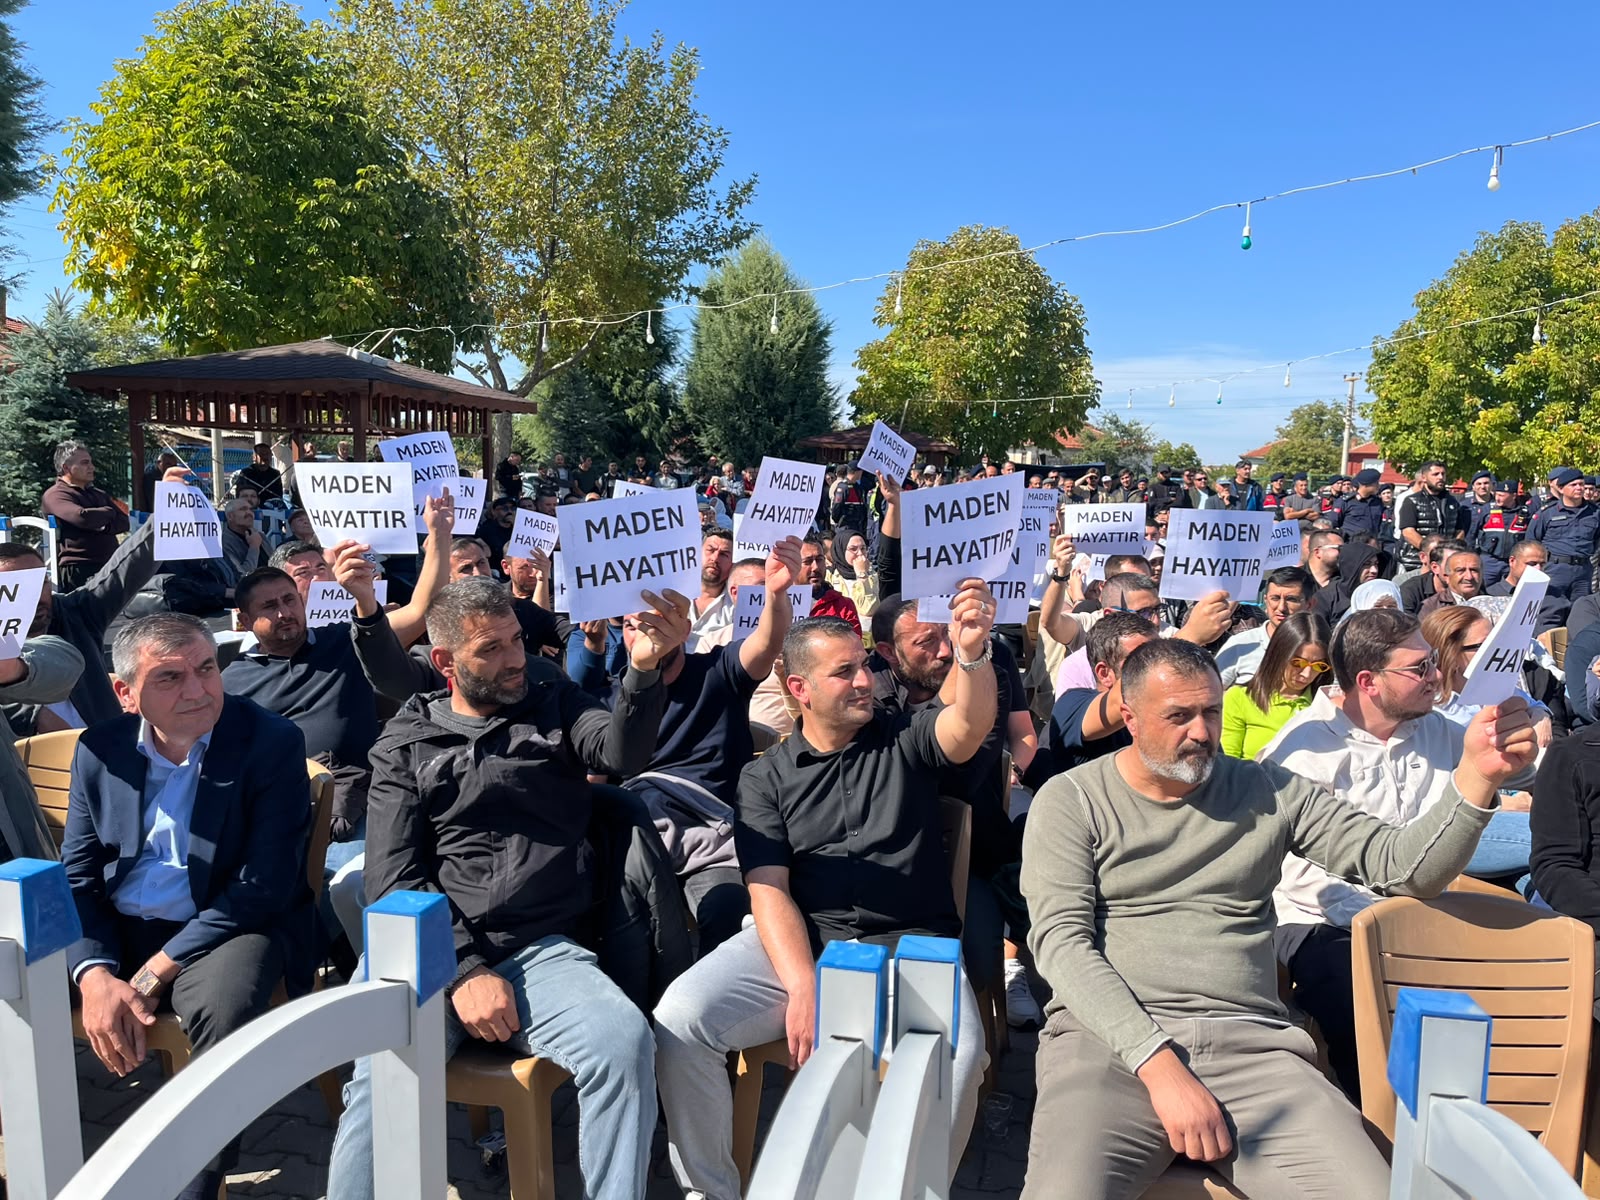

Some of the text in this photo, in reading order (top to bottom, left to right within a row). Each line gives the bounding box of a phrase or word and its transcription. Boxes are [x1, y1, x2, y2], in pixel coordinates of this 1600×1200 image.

[396, 440, 447, 460] MADEN
[879, 431, 908, 459] MADEN
[868, 446, 905, 479] HAYATTIR
[414, 464, 457, 484] AYATTIR
[770, 471, 815, 493] MADEN
[311, 475, 392, 494] MADEN
[1028, 492, 1053, 501] MADEN
[751, 502, 814, 524] HAYATTIR
[924, 489, 1010, 526] MADEN
[1078, 511, 1133, 523] MADEN
[309, 508, 407, 529] HAYATTIR
[524, 516, 557, 534] MADEN
[585, 505, 684, 543] MADEN
[160, 521, 218, 538] HAYATTIR
[1071, 532, 1139, 544] HAYATTIR
[1188, 522, 1260, 542] MADEN
[1270, 526, 1294, 540] ADEN
[514, 533, 554, 552] HAYATTIR
[737, 541, 771, 553] HAYA
[912, 529, 1014, 570] HAYATTIR
[1267, 543, 1299, 559] AYATTIR
[575, 546, 697, 590] HAYATTIR
[1172, 557, 1261, 577] HAYATTIR
[309, 609, 349, 620] HAYA
